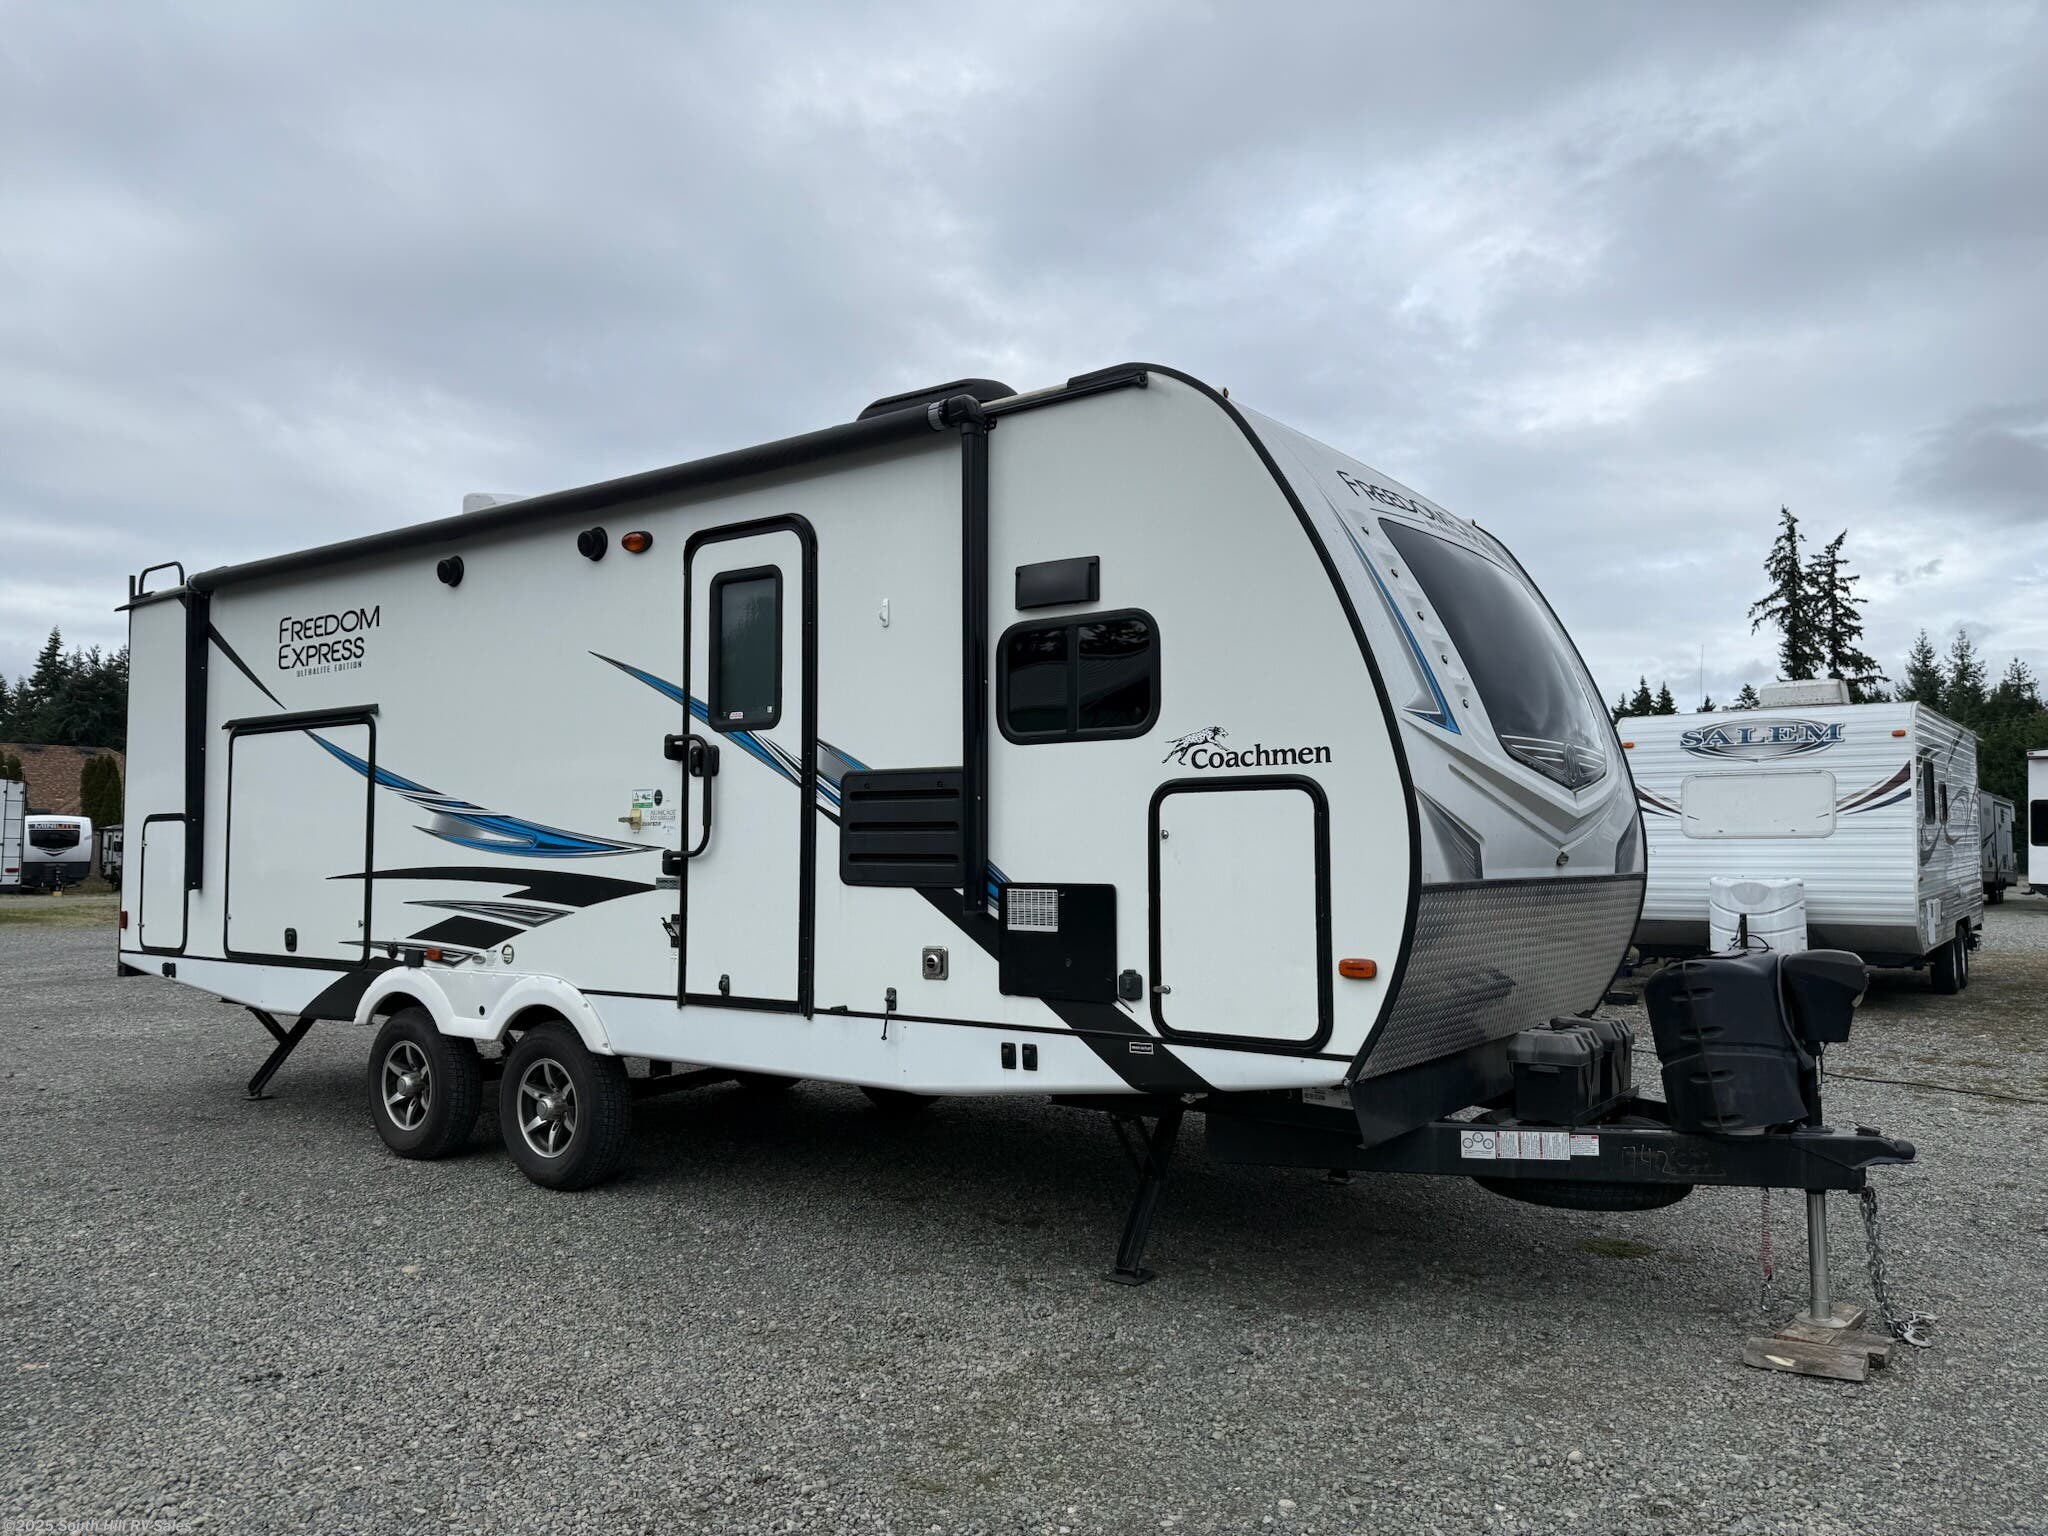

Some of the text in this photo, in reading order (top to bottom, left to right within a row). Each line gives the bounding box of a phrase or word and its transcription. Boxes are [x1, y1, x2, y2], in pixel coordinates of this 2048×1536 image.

[279, 605, 380, 644] FREEDOM
[278, 636, 365, 670] EXPRESS
[296, 660, 362, 678] ULTRALITE EDITION
[1680, 721, 1845, 749] SALEM
[1191, 743, 1332, 770] Coachmen
